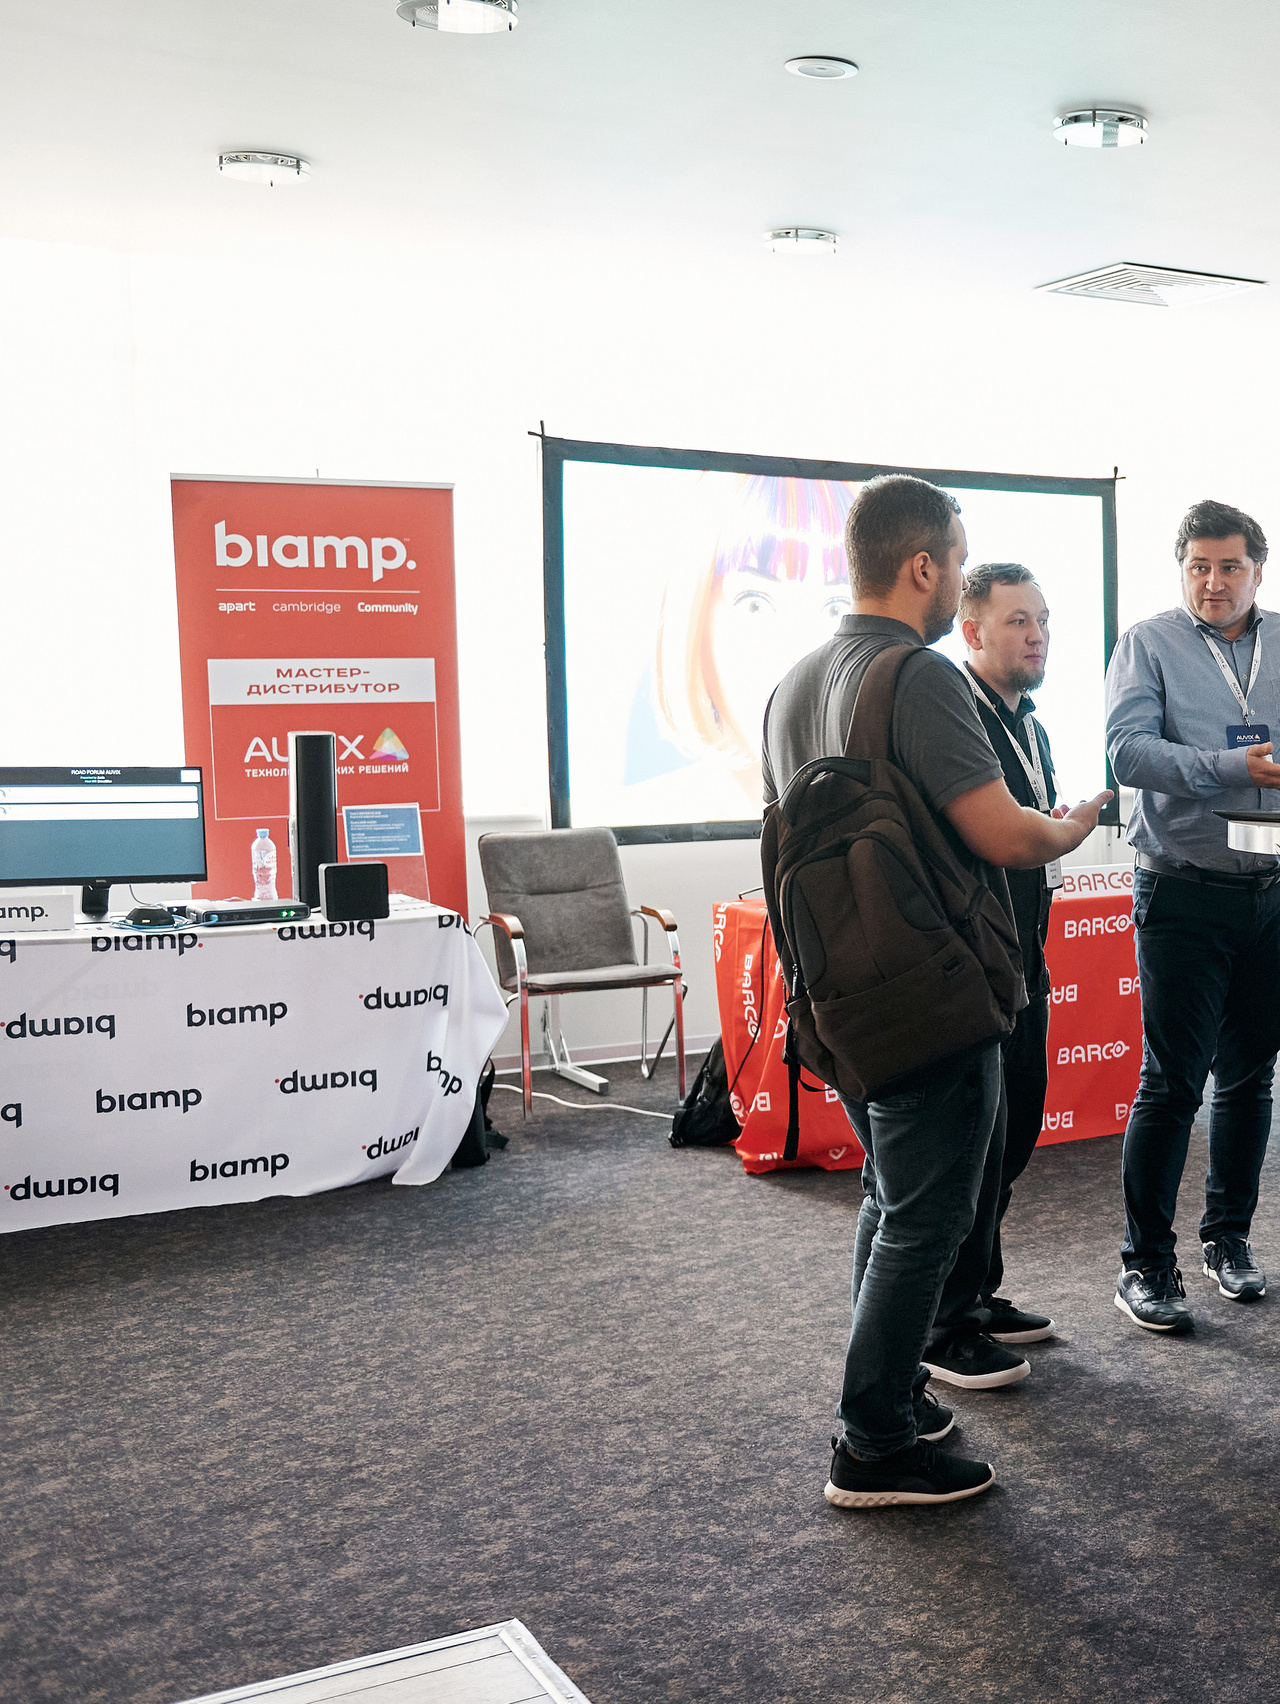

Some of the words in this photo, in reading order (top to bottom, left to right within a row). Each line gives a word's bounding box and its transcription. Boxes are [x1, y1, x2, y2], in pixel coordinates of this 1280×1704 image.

[214, 519, 417, 583] biamp.
[218, 601, 256, 614] apart
[272, 601, 341, 614] cambridge
[357, 602, 418, 615] Community
[276, 668, 370, 678] МАСТЕР-
[246, 683, 400, 696] ДИСТРИБУТОР
[243, 734, 365, 763] AUX
[358, 762, 409, 774] РЕШЕНИЙ
[1062, 871, 1134, 893] BARCO
[1064, 914, 1135, 939] BARCO
[1056, 1040, 1130, 1065] BARCO
